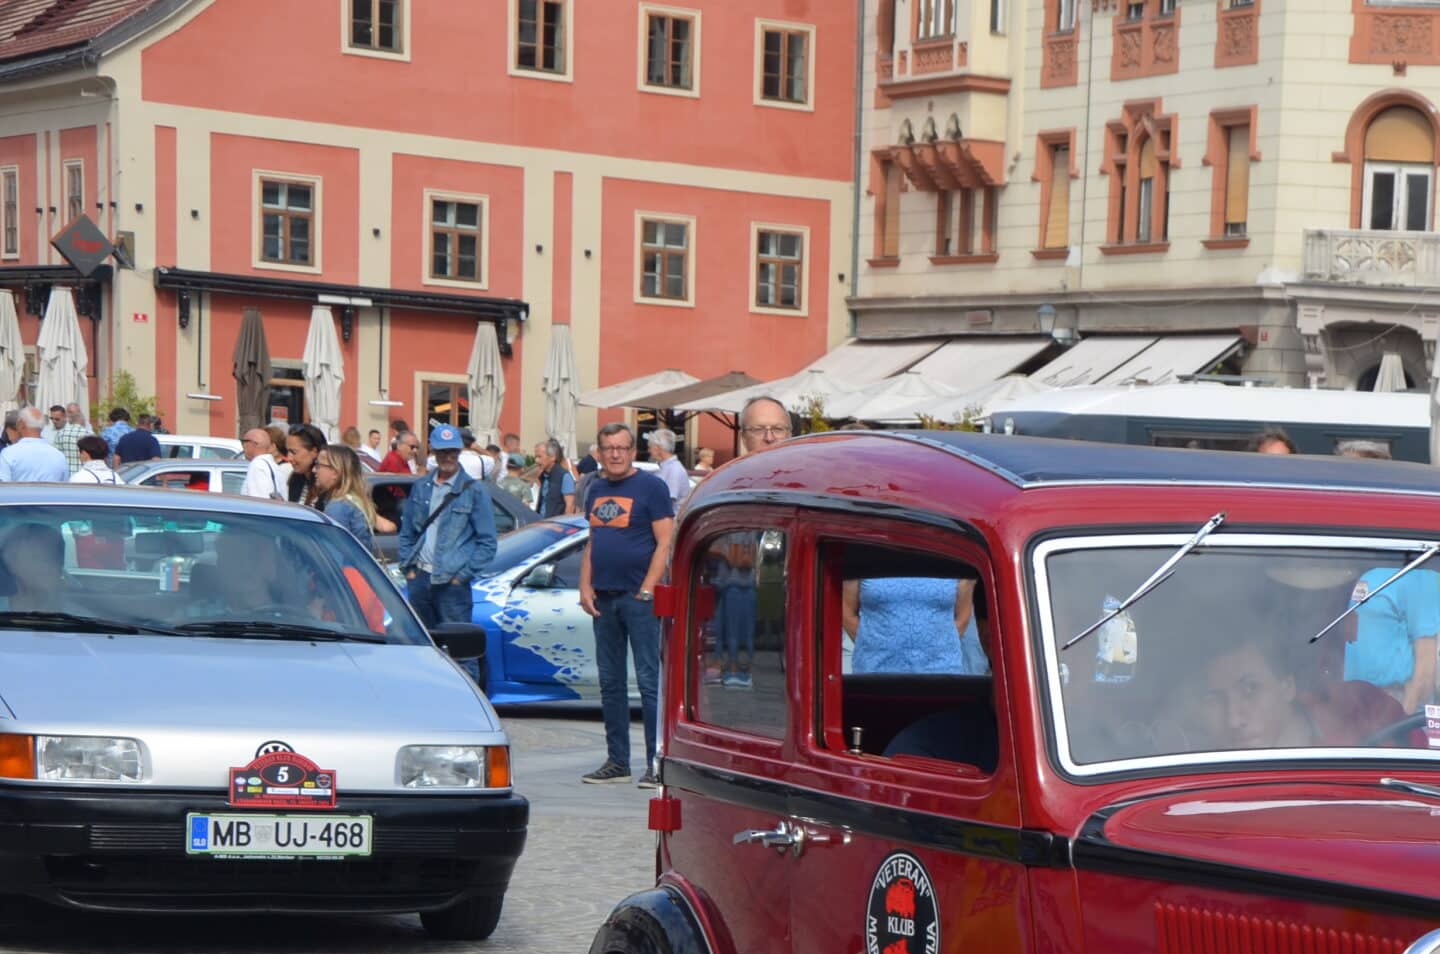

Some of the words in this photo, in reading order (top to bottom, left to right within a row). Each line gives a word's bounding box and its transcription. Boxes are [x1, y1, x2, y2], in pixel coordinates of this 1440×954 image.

[277, 766, 289, 783] 5
[213, 821, 251, 847] MB
[275, 821, 363, 848] UJ-468
[887, 916, 915, 937] KLUB
